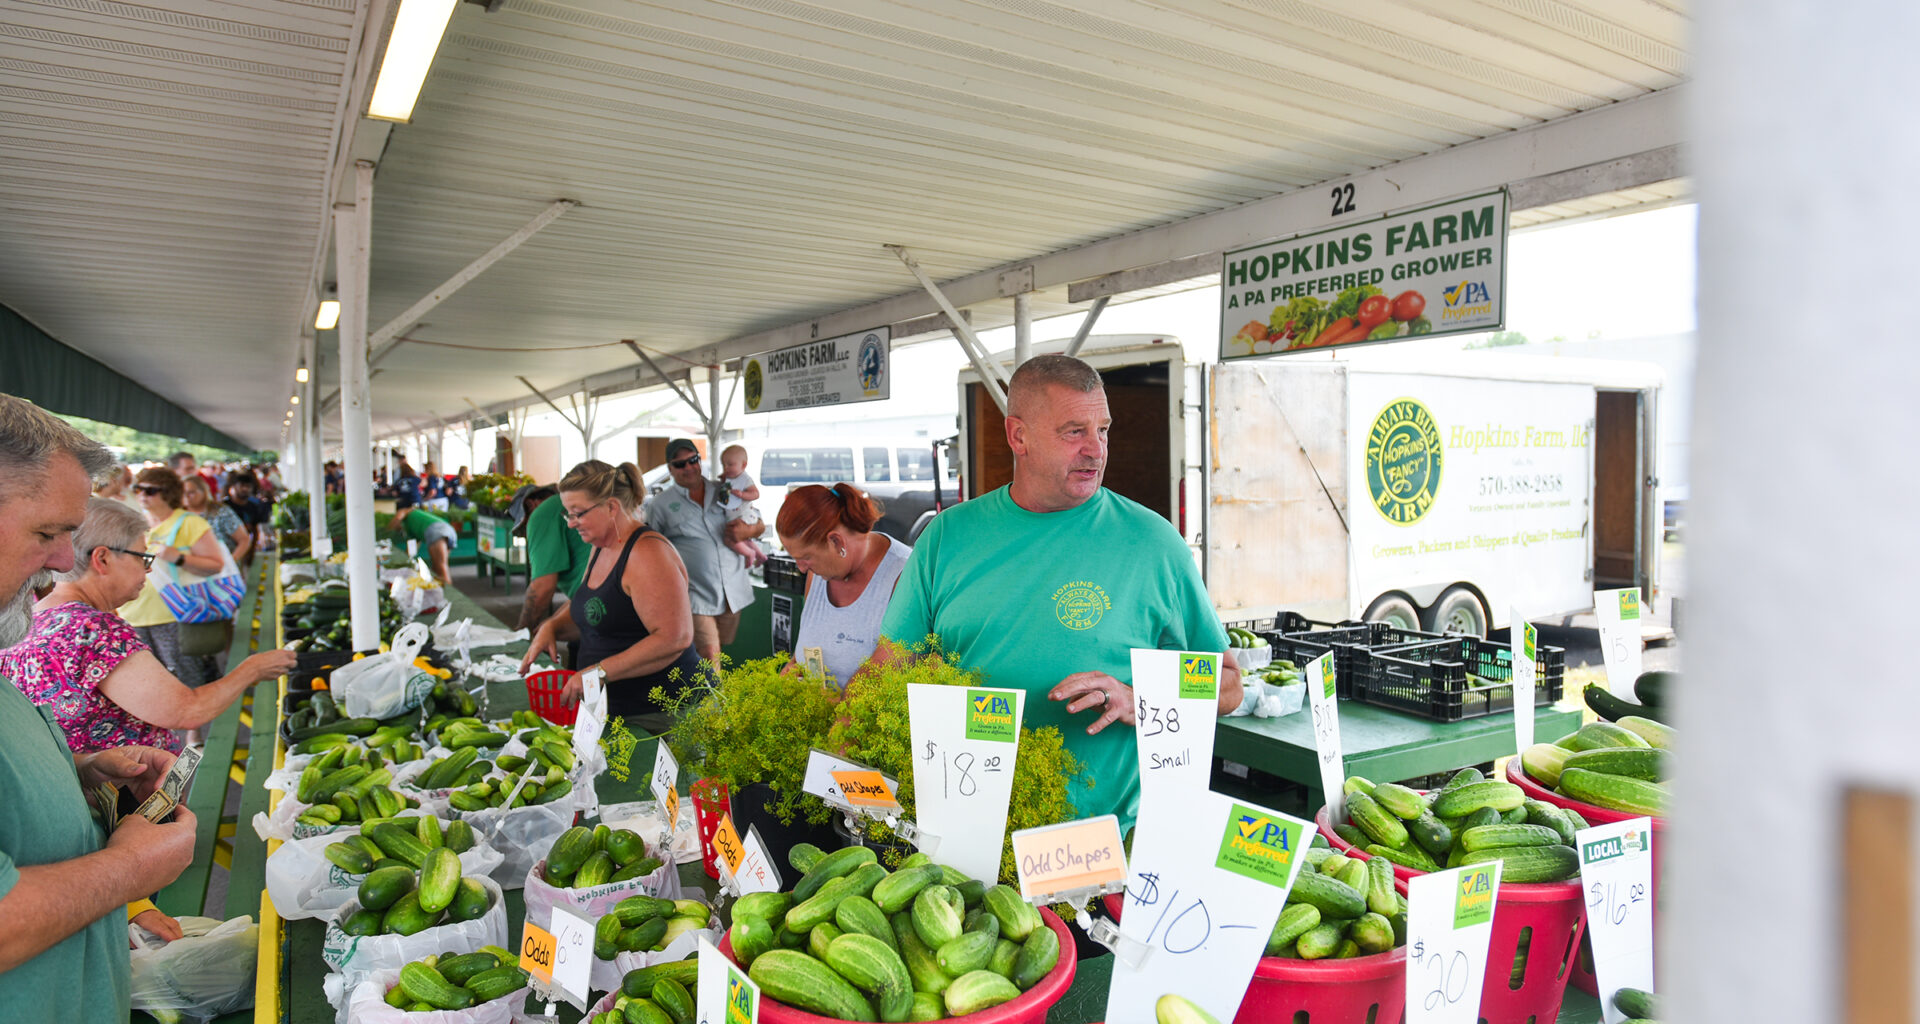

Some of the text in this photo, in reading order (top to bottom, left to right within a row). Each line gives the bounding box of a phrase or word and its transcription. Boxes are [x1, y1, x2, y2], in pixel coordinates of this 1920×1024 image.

[1331, 182, 1356, 216] 22
[1228, 205, 1495, 287] HOPKINS FARM
[1228, 247, 1493, 310] A PA PREFERRED GROWER
[1464, 280, 1491, 304] PA
[811, 322, 818, 338] 21
[767, 348, 806, 374] HOPKINS
[1384, 437, 1425, 465] HOPKINS
[1448, 423, 1520, 455] Hopkins
[1525, 424, 1567, 450] Farm,
[1376, 487, 1433, 522] FARM
[1454, 535, 1470, 549] and
[1512, 531, 1520, 544] of
[1051, 581, 1113, 610] HOPKINS FARM
[1061, 615, 1092, 628] FARM
[1198, 659, 1213, 675] PA
[992, 697, 1011, 715] PA
[1149, 748, 1190, 770] Small
[840, 781, 856, 794] Odd
[717, 828, 737, 868] Odds
[1259, 822, 1290, 852] PA
[1023, 843, 1111, 877] Odd Shapes
[1229, 857, 1248, 867] makes
[1236, 852, 1257, 863] Grown
[1588, 840, 1620, 861] LOCAL
[1476, 872, 1490, 892] PA
[524, 935, 550, 967] Odds
[739, 986, 751, 1017] PA
